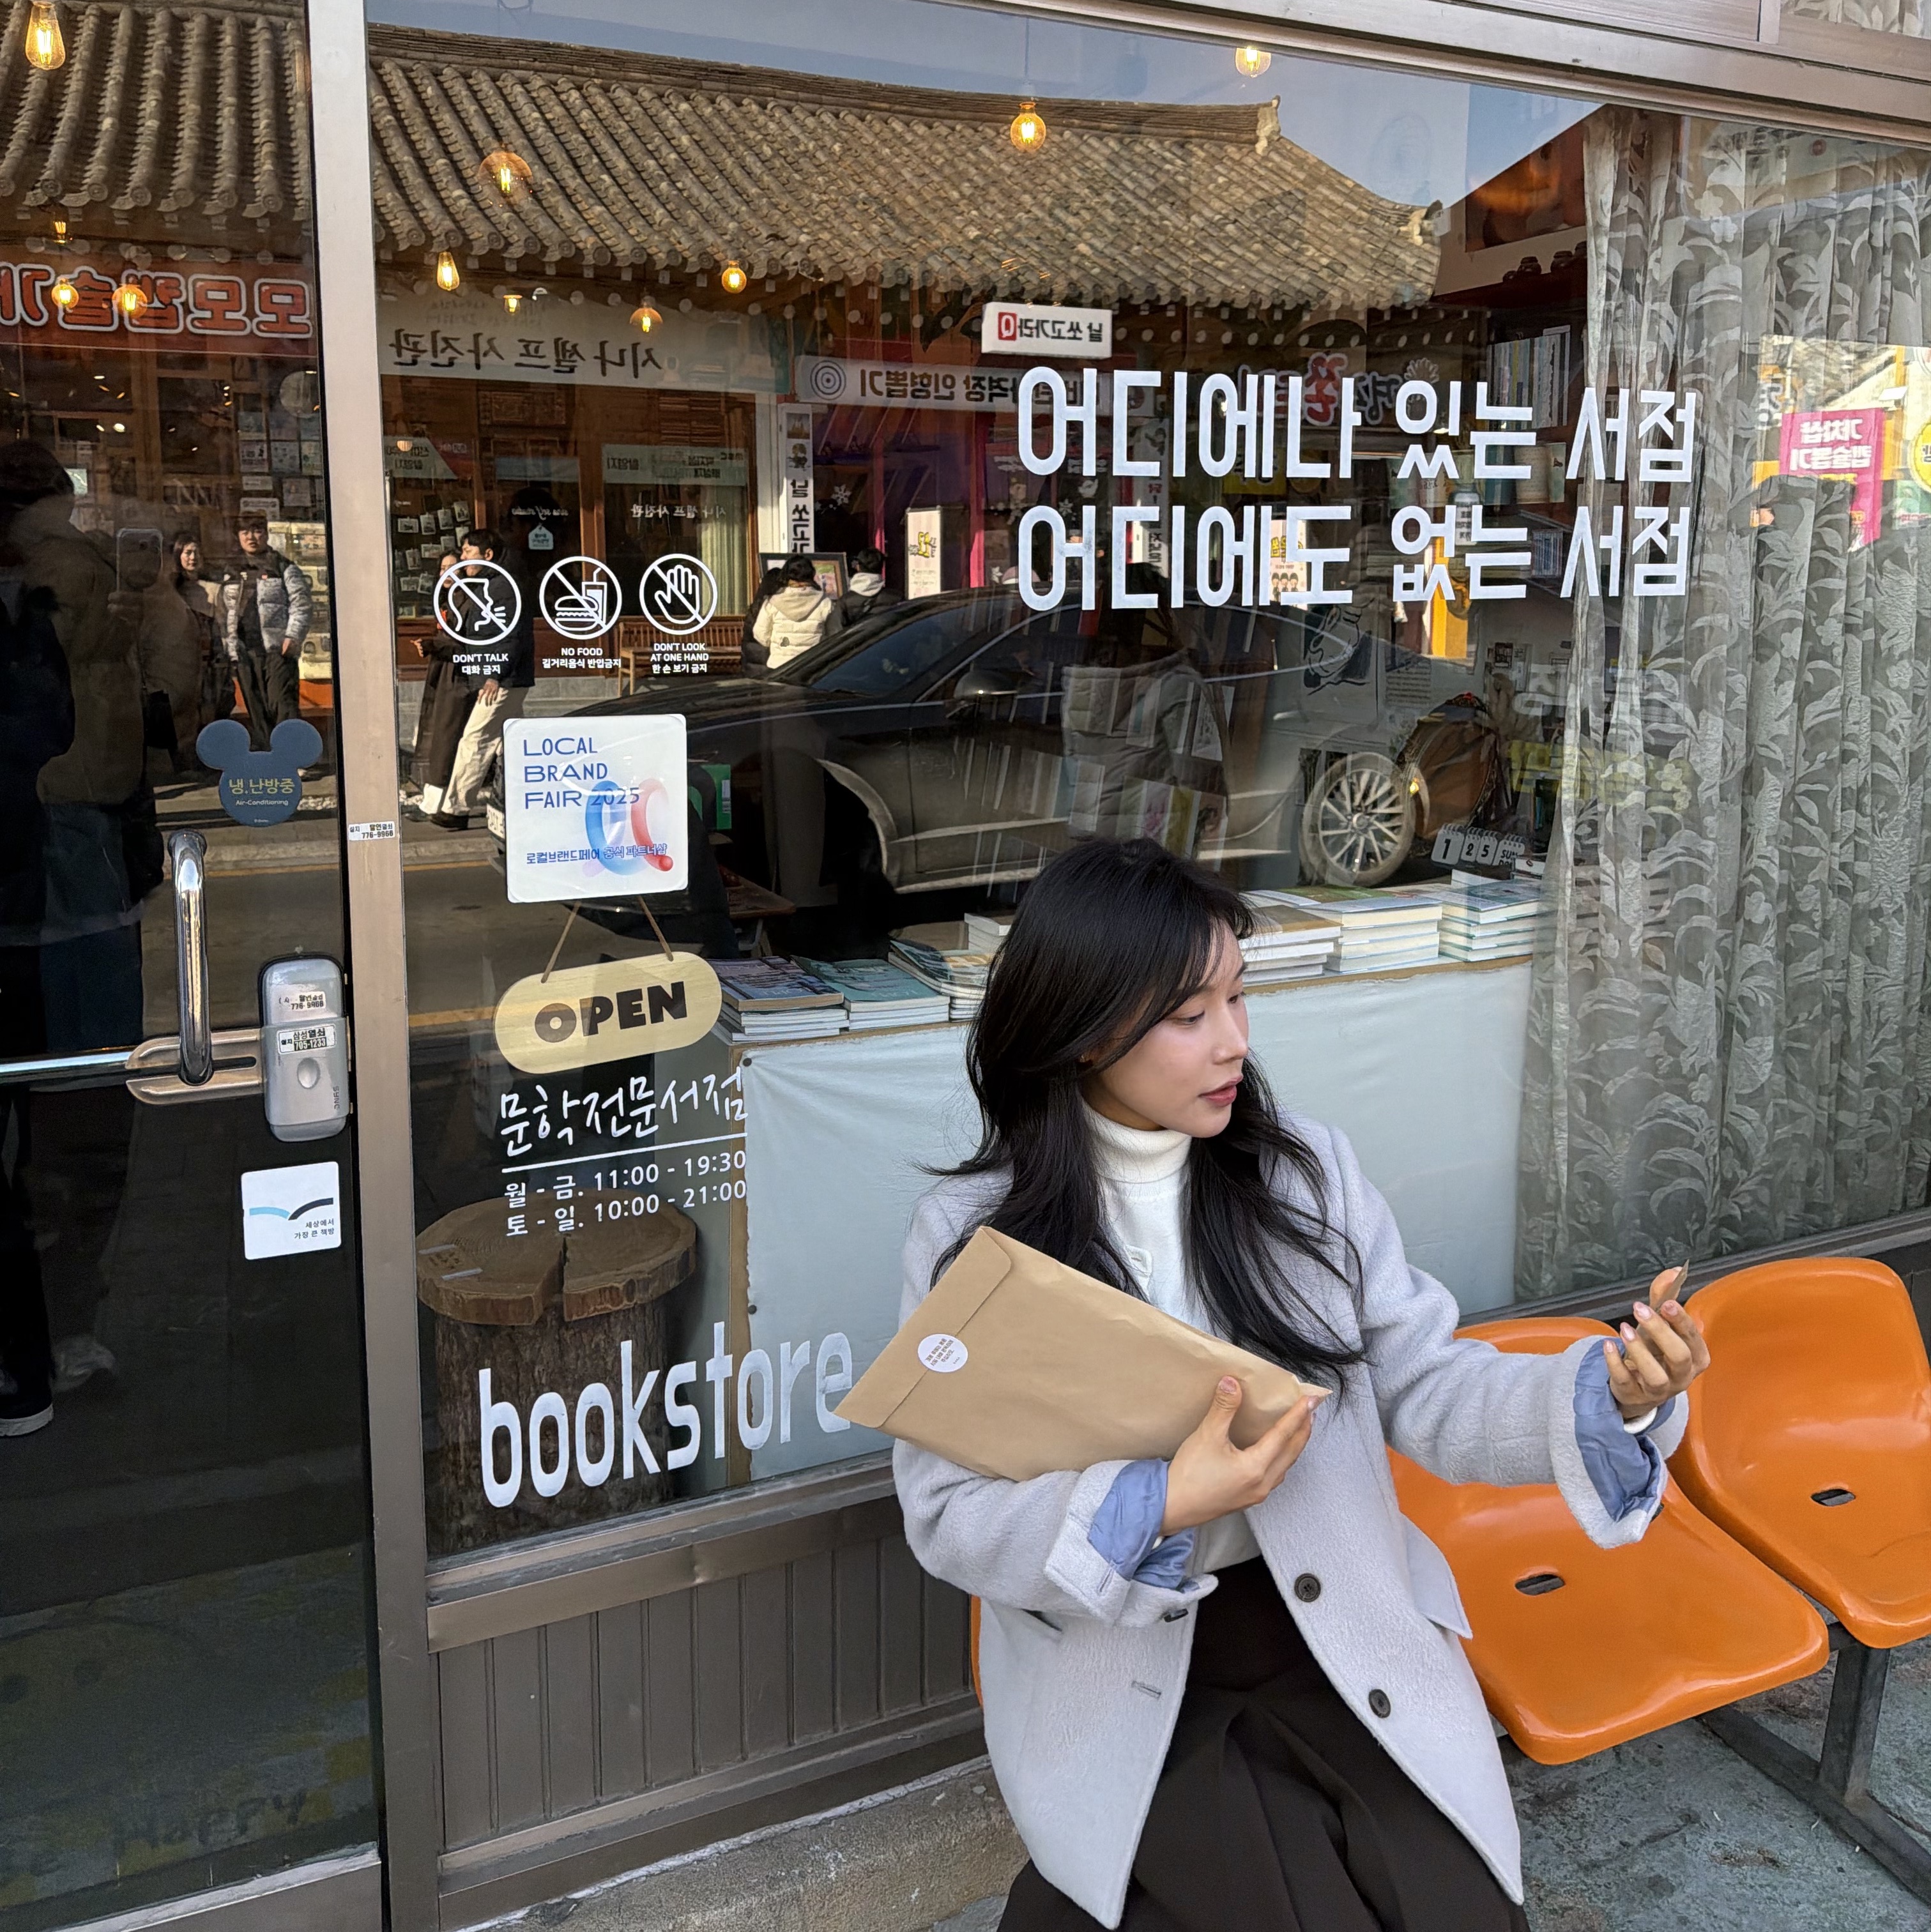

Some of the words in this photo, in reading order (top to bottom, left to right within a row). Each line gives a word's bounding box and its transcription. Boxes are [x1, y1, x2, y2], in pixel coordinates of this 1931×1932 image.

[1018, 366, 1361, 478] 어디에나
[1396, 381, 1536, 479] 있는
[1566, 387, 1697, 483] 서점
[1018, 505, 1353, 611] 어디에도
[1391, 505, 1532, 602] 없는
[1560, 506, 1690, 597] 서점
[561, 648, 575, 656] NO
[577, 648, 603, 656] FOOD
[653, 643, 680, 651] DON'T
[682, 643, 706, 651] LOOK
[453, 653, 482, 663] DON'T
[484, 653, 509, 662] TALK
[542, 658, 585, 669] 길거리음식
[587, 658, 622, 669] 반입금지
[650, 653, 662, 662] AT
[663, 653, 682, 662] ONE
[683, 653, 709, 661] HAND
[462, 665, 480, 675] 대화
[482, 664, 501, 674] 금지
[652, 664, 661, 674] 한
[662, 664, 671, 674] 손
[673, 664, 689, 673] 보기
[691, 664, 708, 674] 금지
[523, 737, 598, 756] LOCAL
[524, 763, 608, 783] BRAND
[525, 789, 583, 809] FAIR
[590, 787, 640, 806] 2025
[526, 848, 600, 865] 로컬브랜드페어
[603, 846, 625, 860] 공식
[627, 842, 668, 856] 파트너샵
[1442, 838, 1451, 860] 1
[1465, 842, 1474, 856] 2
[1481, 844, 1490, 858] 5
[534, 981, 687, 1043] OPEN
[294, 1038, 326, 1051] 705-1233
[500, 1066, 748, 1157] 문학전문서점
[504, 1182, 526, 1208] 월
[553, 1176, 584, 1199] 금.
[594, 1164, 659, 1192] 11:00
[684, 1150, 746, 1177] 19:30
[506, 1213, 528, 1237] 토
[554, 1206, 584, 1232] 일.
[595, 1194, 659, 1222] 10:00
[683, 1180, 747, 1208] 21:00
[305, 1218, 335, 1229] 세상에서
[294, 1231, 309, 1240] 가장
[311, 1229, 318, 1238] 큰
[320, 1227, 335, 1236] 책방
[478, 1321, 852, 1509] bookstore
